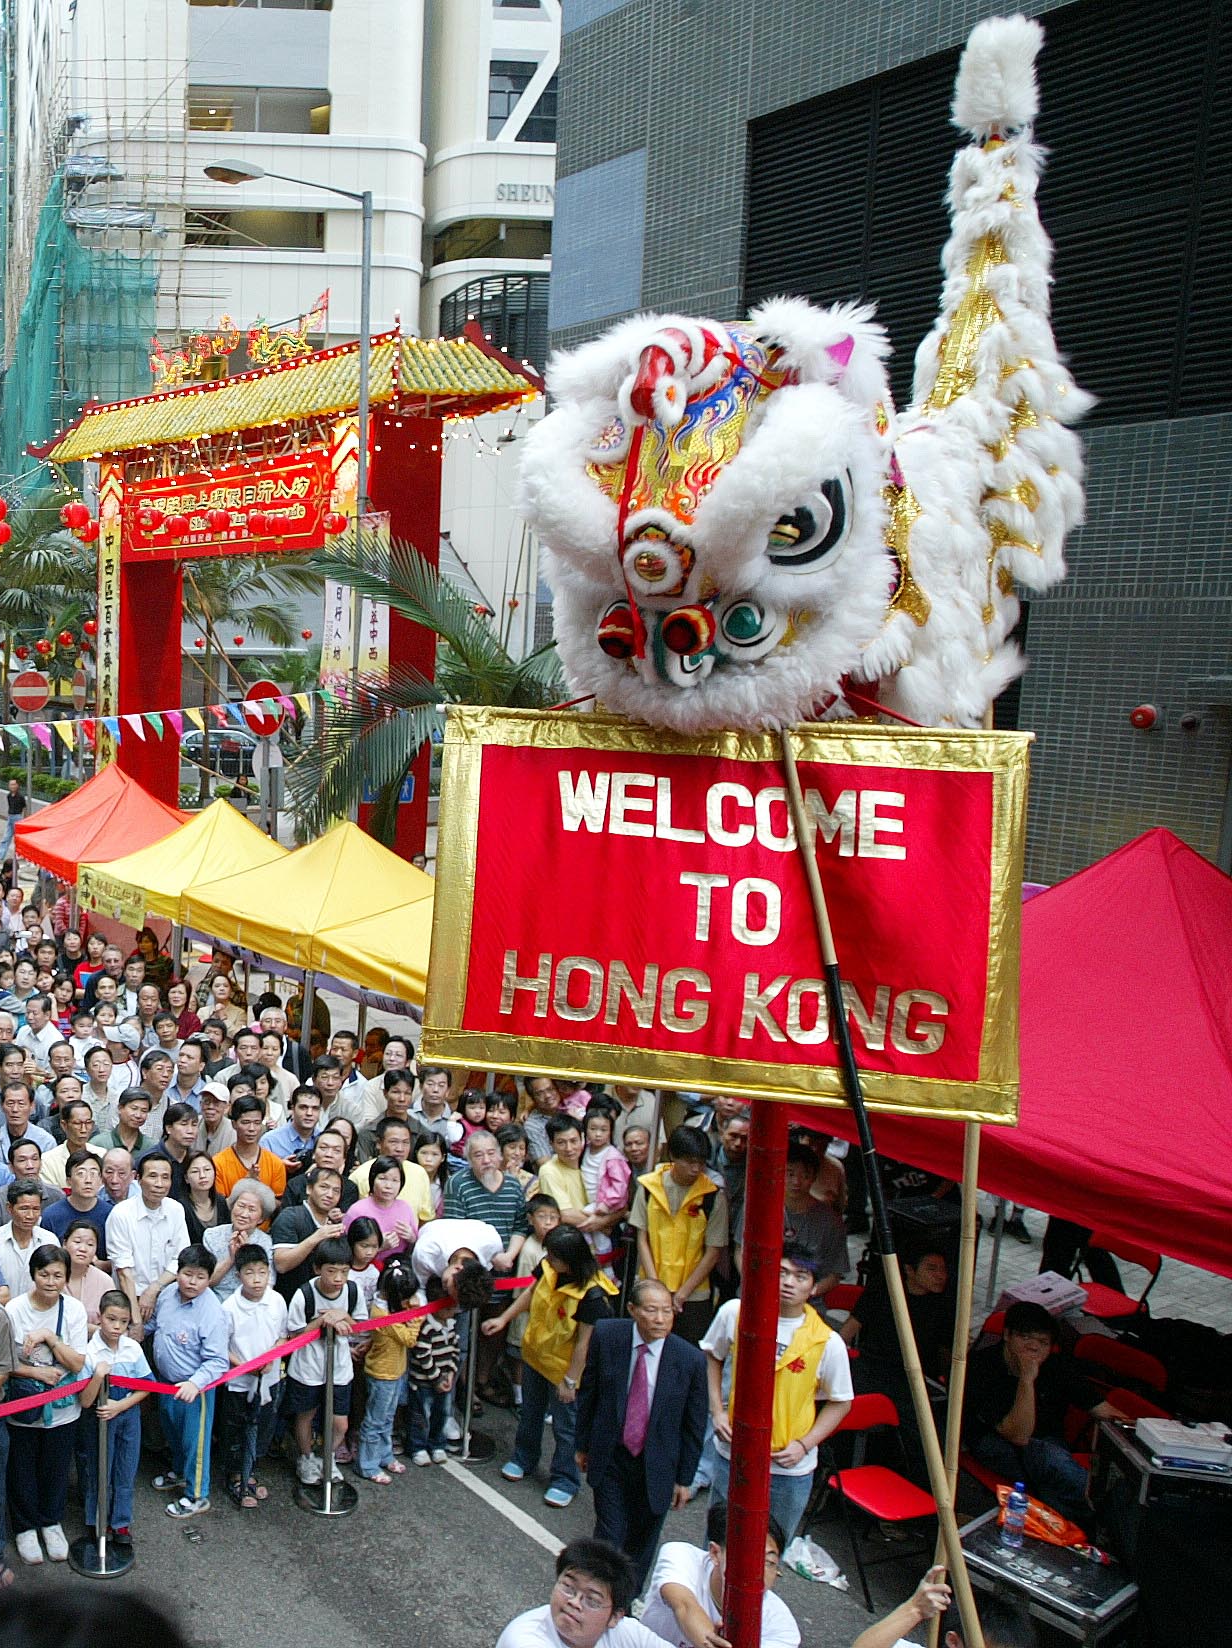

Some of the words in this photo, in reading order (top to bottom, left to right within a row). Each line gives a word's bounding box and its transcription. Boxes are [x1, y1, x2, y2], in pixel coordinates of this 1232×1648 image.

[558, 770, 907, 860] WELCOME
[679, 871, 782, 946] TO
[498, 949, 712, 1034] HONG
[738, 972, 949, 1055] KONG
